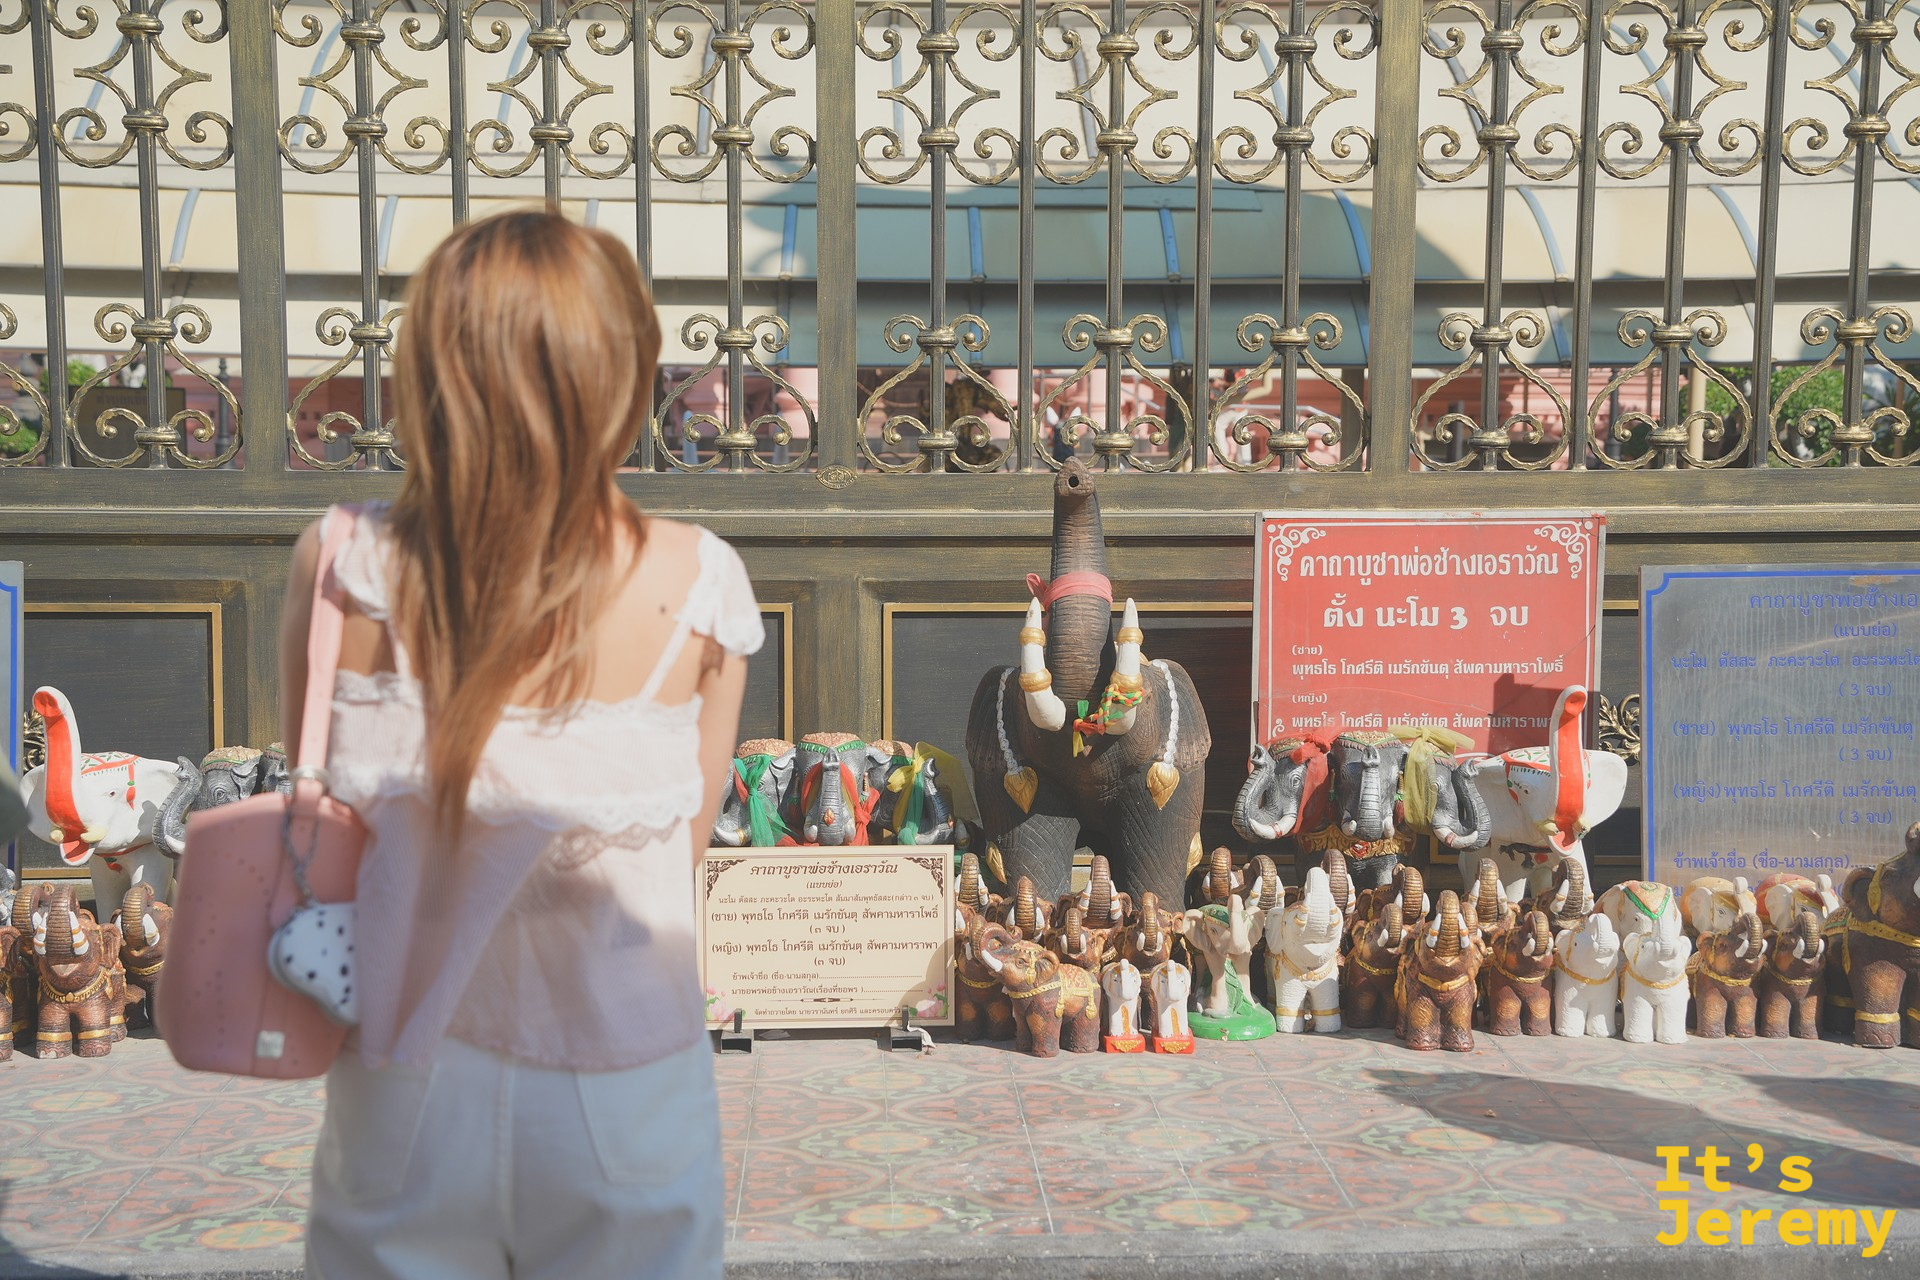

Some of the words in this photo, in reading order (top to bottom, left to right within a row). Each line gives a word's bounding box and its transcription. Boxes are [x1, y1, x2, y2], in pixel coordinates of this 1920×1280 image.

[1300, 545, 1559, 586] คาถาบูชาพ่อช้างเอราวัณ
[1323, 593, 1363, 628] ตั้ง
[1375, 596, 1439, 628] นะโม
[1449, 606, 1469, 630] 3
[1489, 604, 1529, 627] จบ
[1833, 621, 1898, 638] (แบบย่อ)
[1291, 644, 1323, 656] (ชาย)
[1671, 651, 1707, 669] นะโม
[1291, 692, 1328, 705] (หญิง)
[1672, 720, 1716, 737] (ชาย)
[1673, 781, 1721, 804] (หญิง)
[1673, 850, 1746, 869] ข้าพเจ้าชื่อ
[750, 859, 898, 879] คาถาบูชาพ่อช้างเอราวัณ
[805, 880, 843, 889] (แบบย่อ)
[711, 911, 737, 922] (ชาย)
[711, 943, 742, 955] (หญิง)
